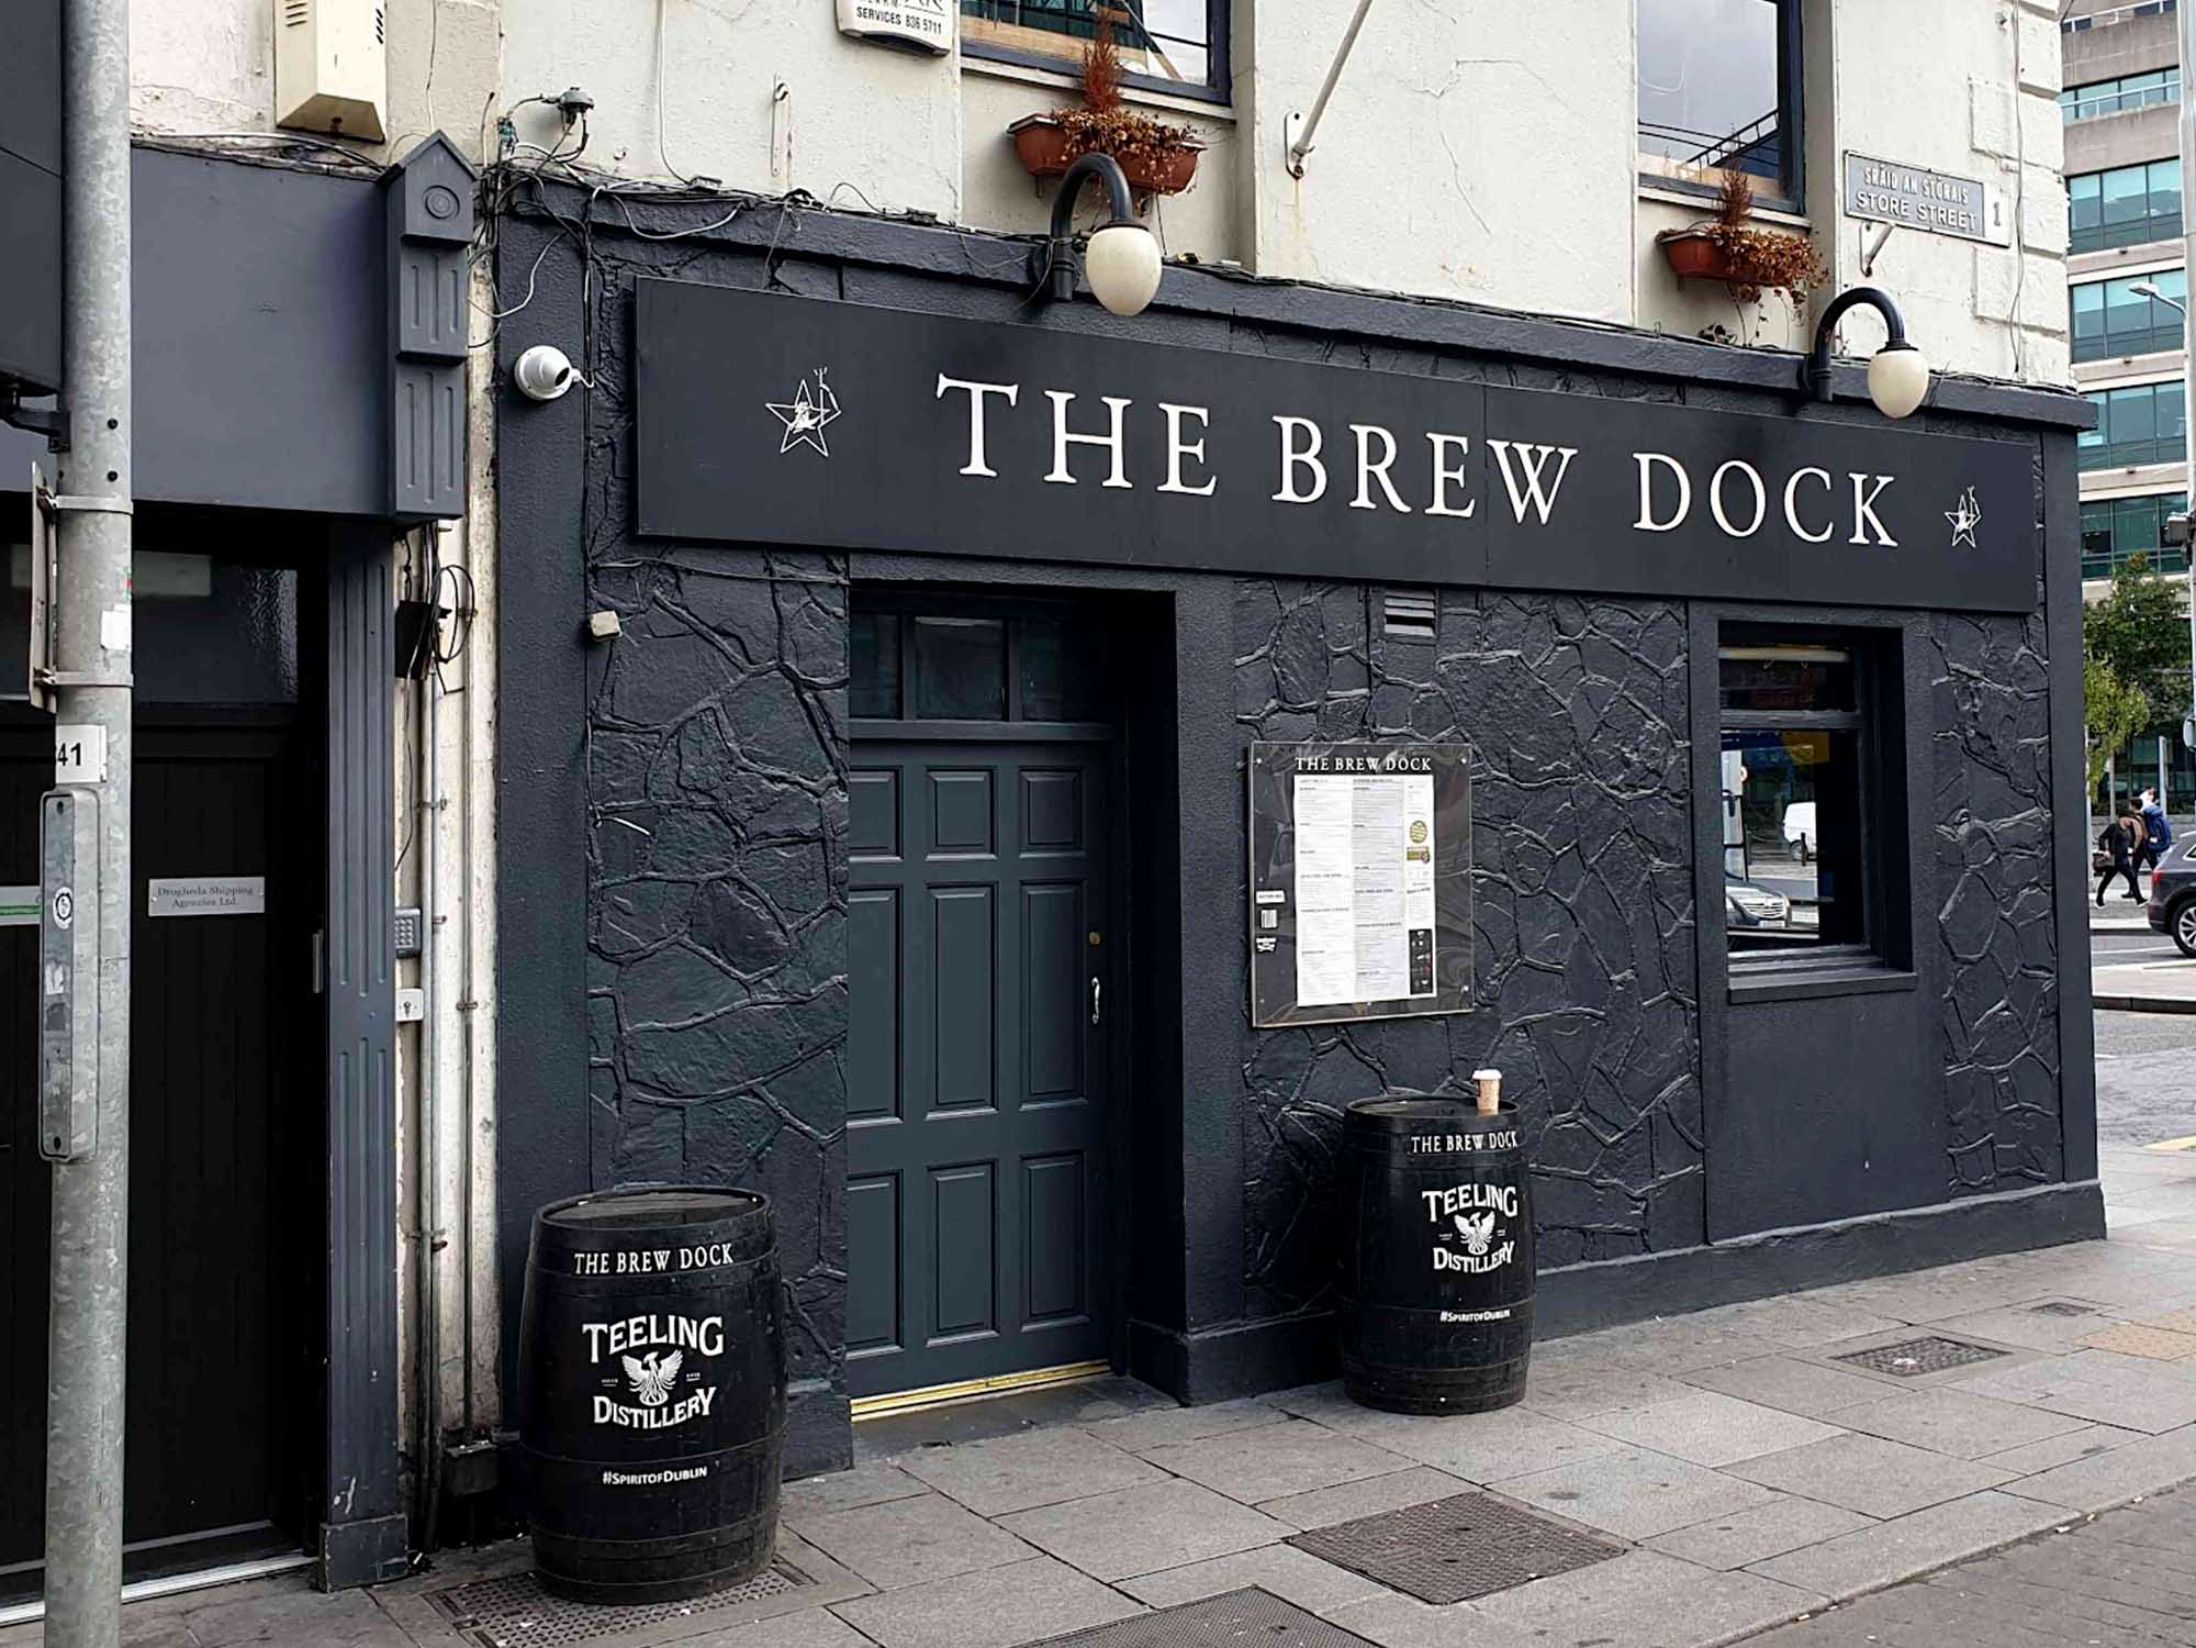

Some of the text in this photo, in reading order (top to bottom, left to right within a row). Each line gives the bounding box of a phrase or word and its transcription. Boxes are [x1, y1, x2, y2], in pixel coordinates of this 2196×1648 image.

[856, 6, 901, 25] SERVICES
[923, 18, 942, 34] 5711
[1903, 175, 1918, 195] AN
[1857, 191, 1976, 230] STORE STREET
[1993, 202, 2001, 226] 1
[936, 373, 1898, 548] THE BREW DOCK
[58, 742, 81, 766] 41
[1295, 757, 1432, 772] THE BREW DOCK
[210, 886, 253, 896] Shipping
[1411, 1130, 1517, 1153] THE BREW DOCK
[1422, 1183, 1517, 1222] TEELING
[574, 1243, 734, 1275] THE BREW DOCK
[1433, 1240, 1515, 1273] DISTILLERY
[582, 1314, 724, 1364] TEELING
[593, 1386, 717, 1430] DISTILLERY
